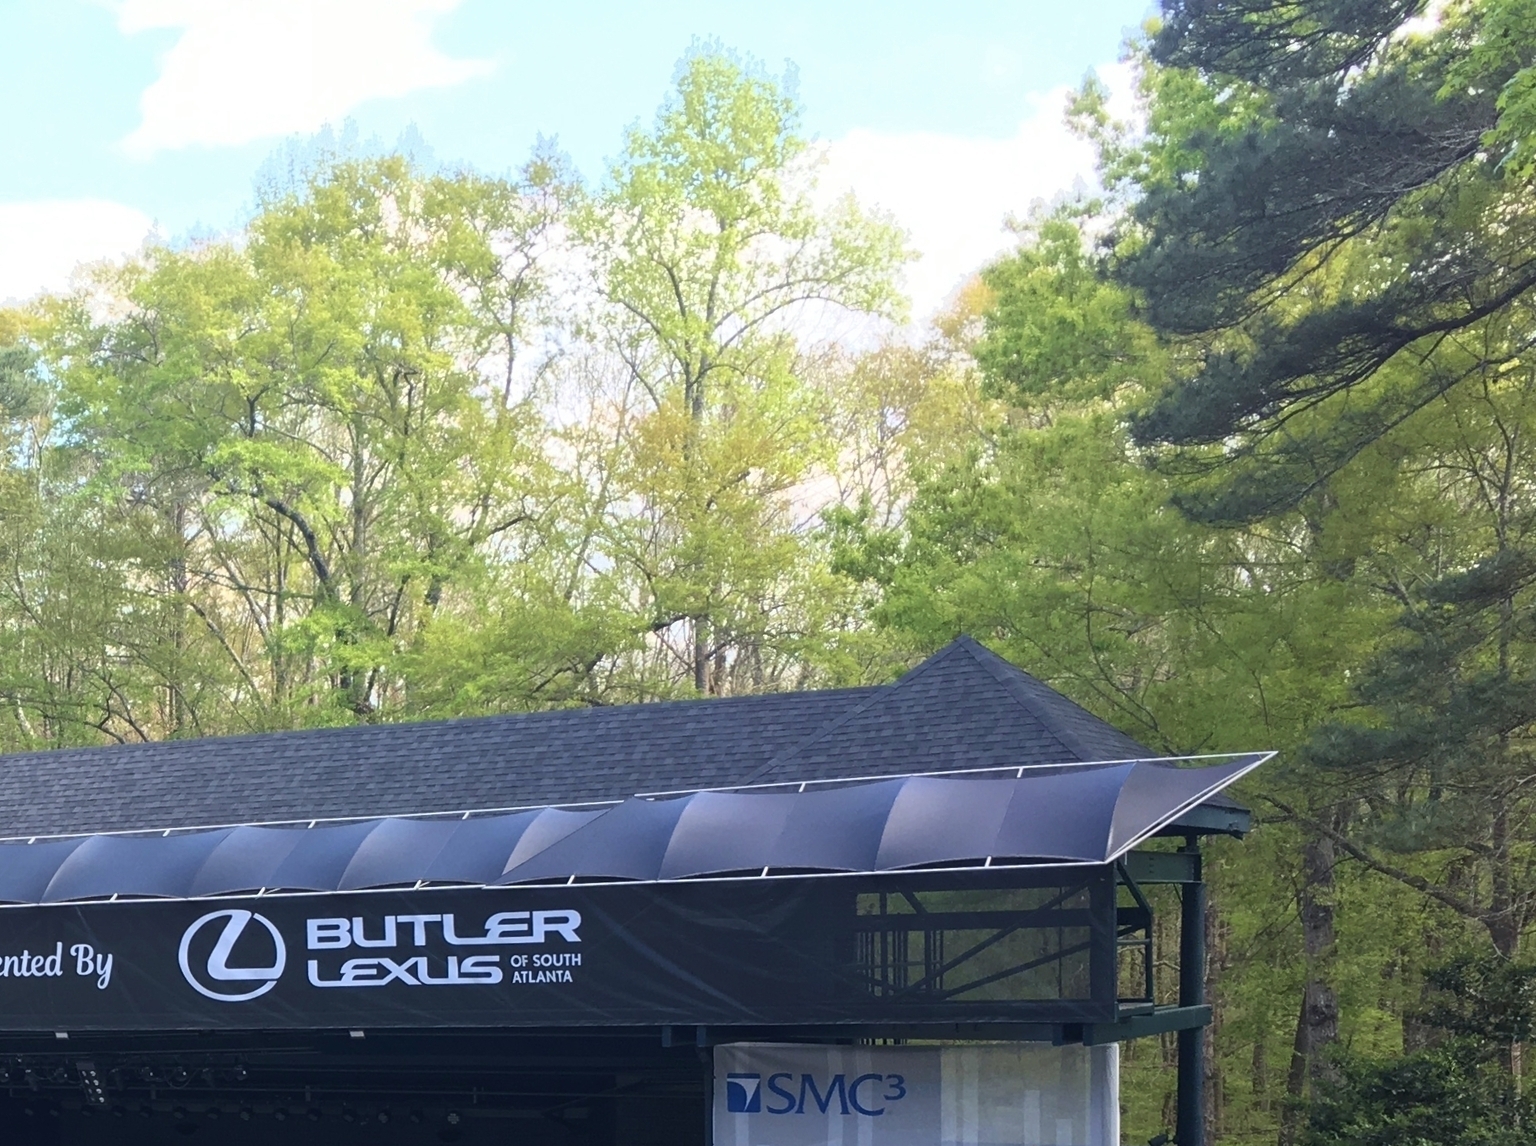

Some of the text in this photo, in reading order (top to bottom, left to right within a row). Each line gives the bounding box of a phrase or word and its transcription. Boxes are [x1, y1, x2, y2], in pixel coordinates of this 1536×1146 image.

[307, 909, 582, 949] BUTLER
[70, 944, 113, 989] By
[307, 955, 503, 988] LEXUS
[510, 953, 581, 967] OF SOUTH
[512, 970, 573, 984] ATLANTA
